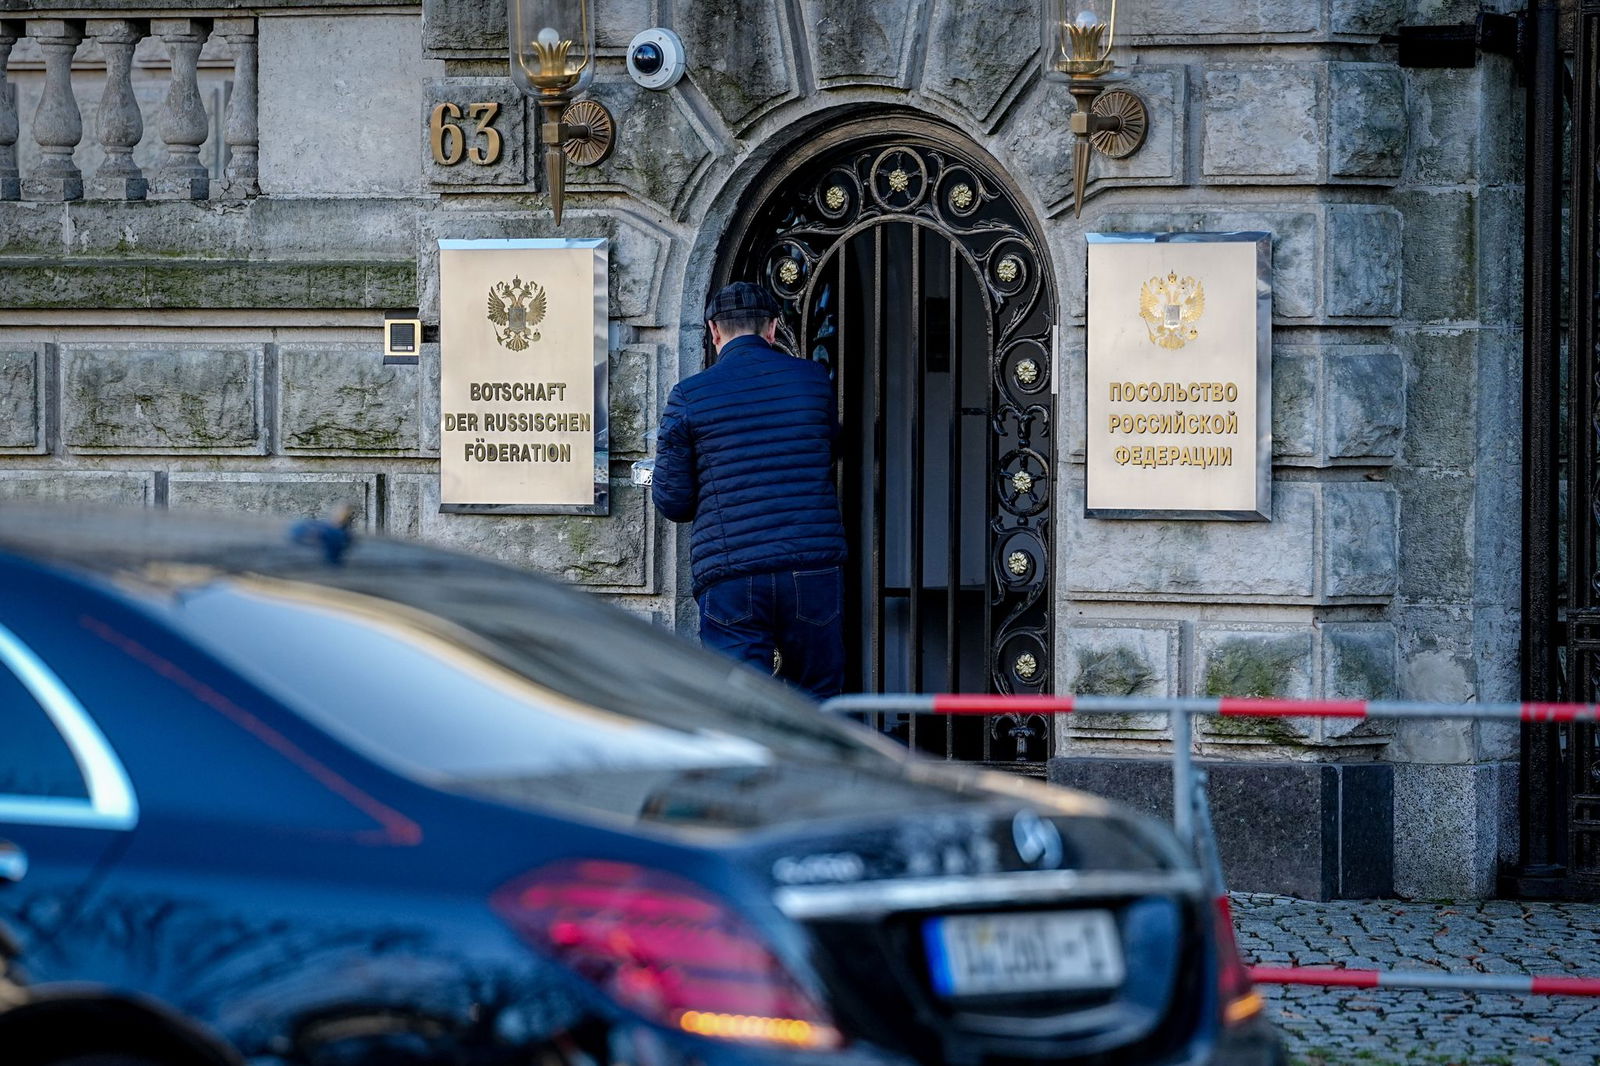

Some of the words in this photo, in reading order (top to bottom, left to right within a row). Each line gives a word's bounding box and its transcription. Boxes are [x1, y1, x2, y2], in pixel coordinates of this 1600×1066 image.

[429, 101, 502, 166] 63
[470, 382, 566, 402] BOTSCHAFT
[1109, 382, 1238, 402] ПОСОЛЬСТВО
[444, 413, 479, 432] DER
[484, 413, 591, 432] RUSSISCHEN
[1108, 410, 1238, 434] РОССИЙСКОЙ
[464, 438, 571, 462] FÖDERATION
[1114, 446, 1232, 469] ФЕДЕРАЦИИ
